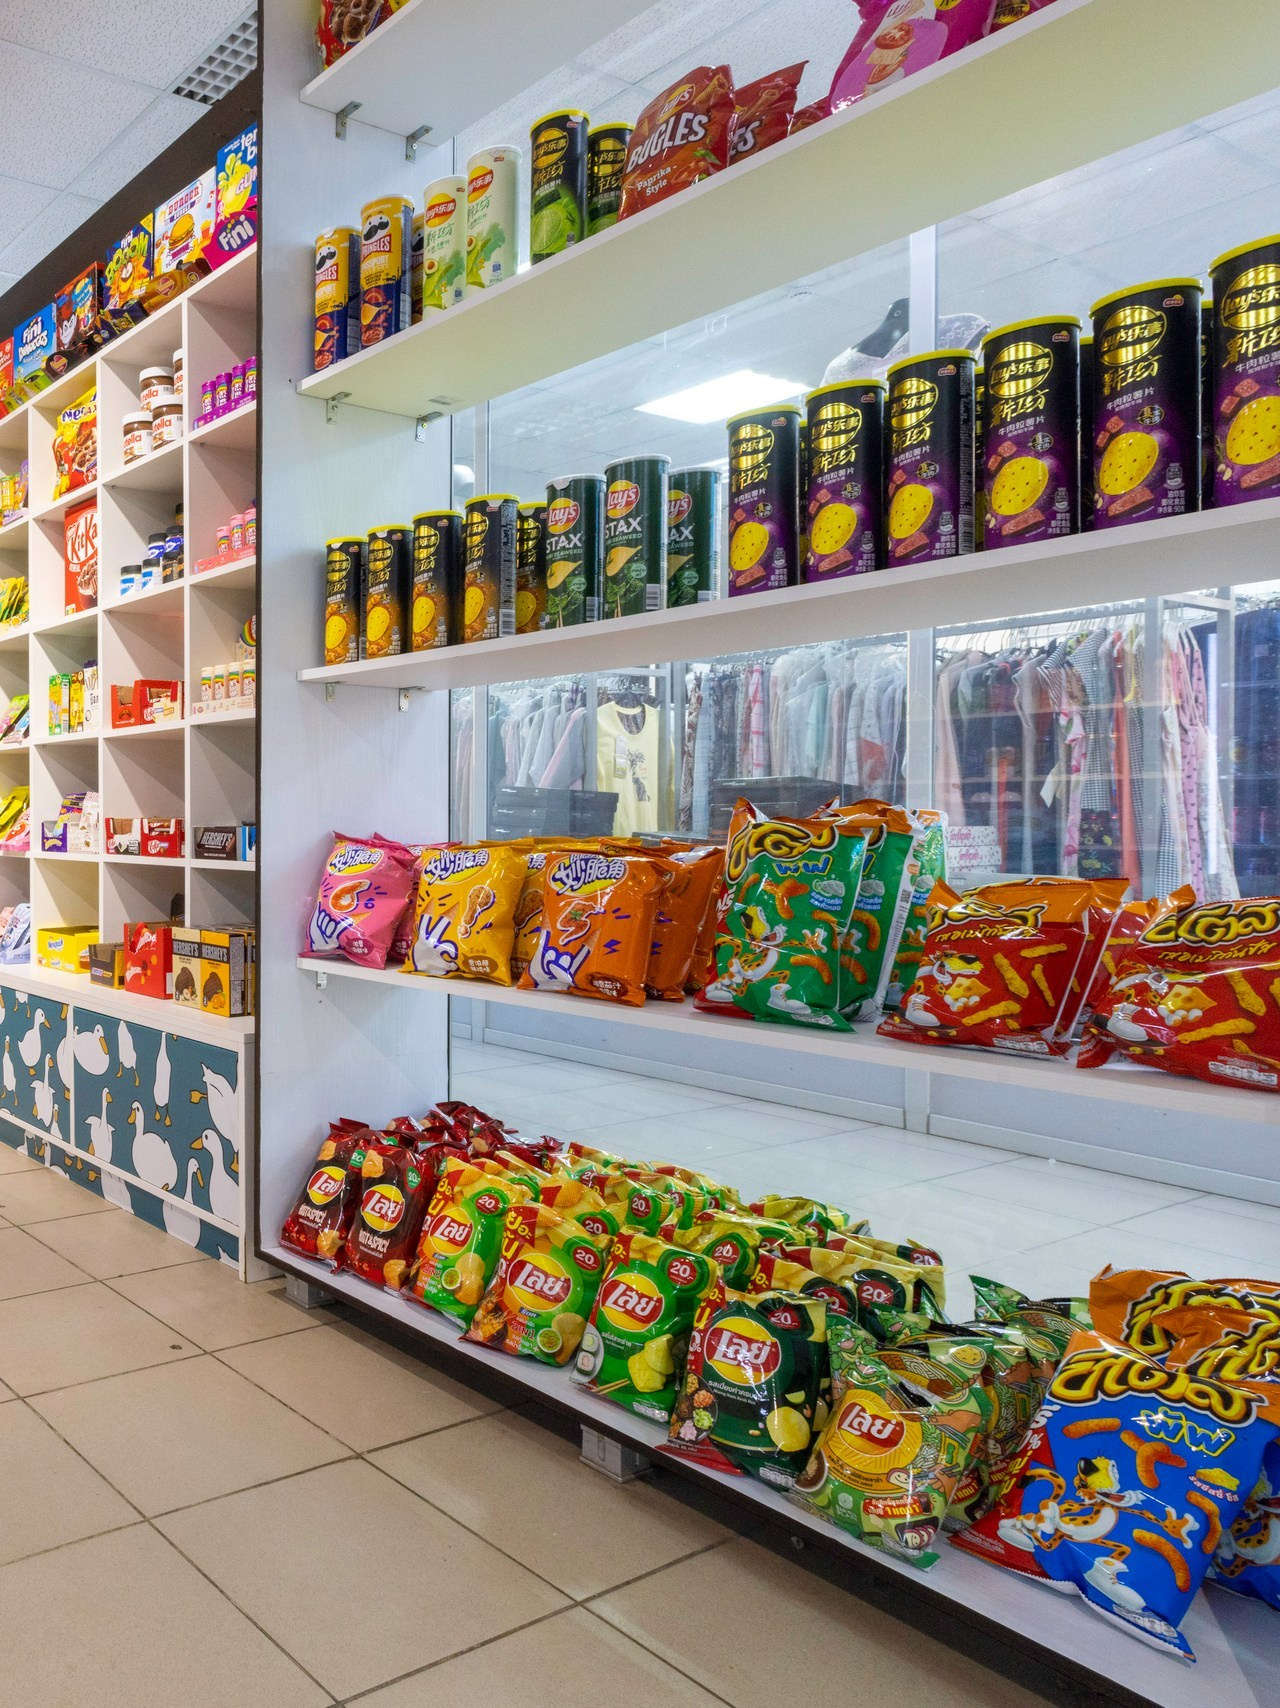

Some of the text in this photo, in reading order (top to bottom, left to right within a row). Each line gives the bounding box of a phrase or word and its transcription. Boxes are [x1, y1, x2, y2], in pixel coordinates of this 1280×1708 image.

[626, 113, 709, 173] BUGLES
[636, 166, 671, 191] Paprika
[646, 178, 667, 197] Style
[219, 214, 255, 251] Fini
[23, 317, 42, 343] Fini
[141, 389, 158, 402] tella
[123, 434, 141, 448] tella
[607, 487, 637, 510] Lay's
[548, 504, 577, 527] Lay's
[69, 515, 97, 561] KitKa
[605, 516, 642, 539] STAX
[669, 526, 694, 542] AX
[546, 533, 582, 554] STAX
[201, 831, 233, 846] HERSHEY'S
[330, 847, 383, 877] 妙脆角
[425, 850, 489, 884] 妙脆角
[552, 858, 625, 896] 妙脆角
[173, 941, 198, 957] HERSHEY'S
[202, 945, 227, 962] HERSHEY'S
